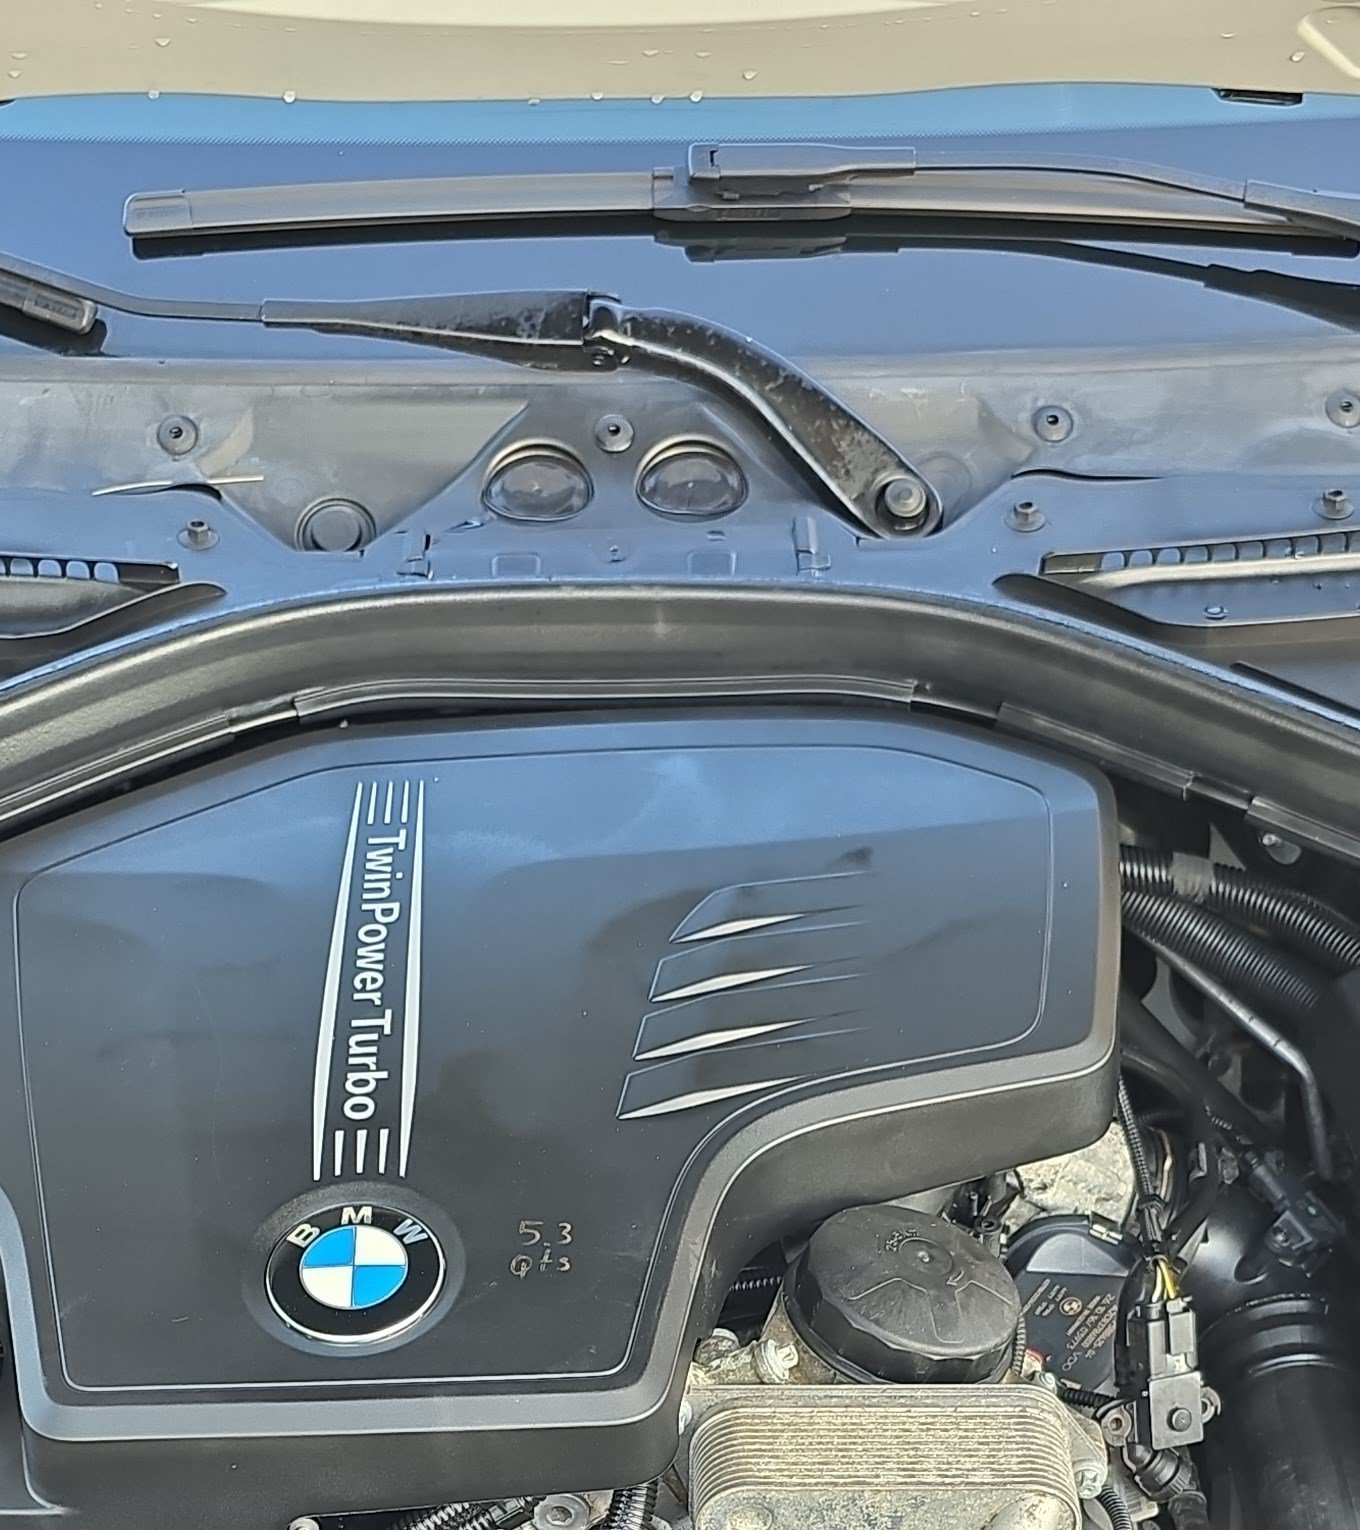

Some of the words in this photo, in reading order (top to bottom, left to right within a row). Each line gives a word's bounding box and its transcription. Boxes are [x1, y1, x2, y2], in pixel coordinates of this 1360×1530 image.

[351, 828, 407, 1006] TwinPower
[342, 1008, 394, 1121] Turbo
[286, 1205, 430, 1249] BMW
[518, 1219, 573, 1247] 5.3
[1062, 1351, 1082, 1372] VDO
